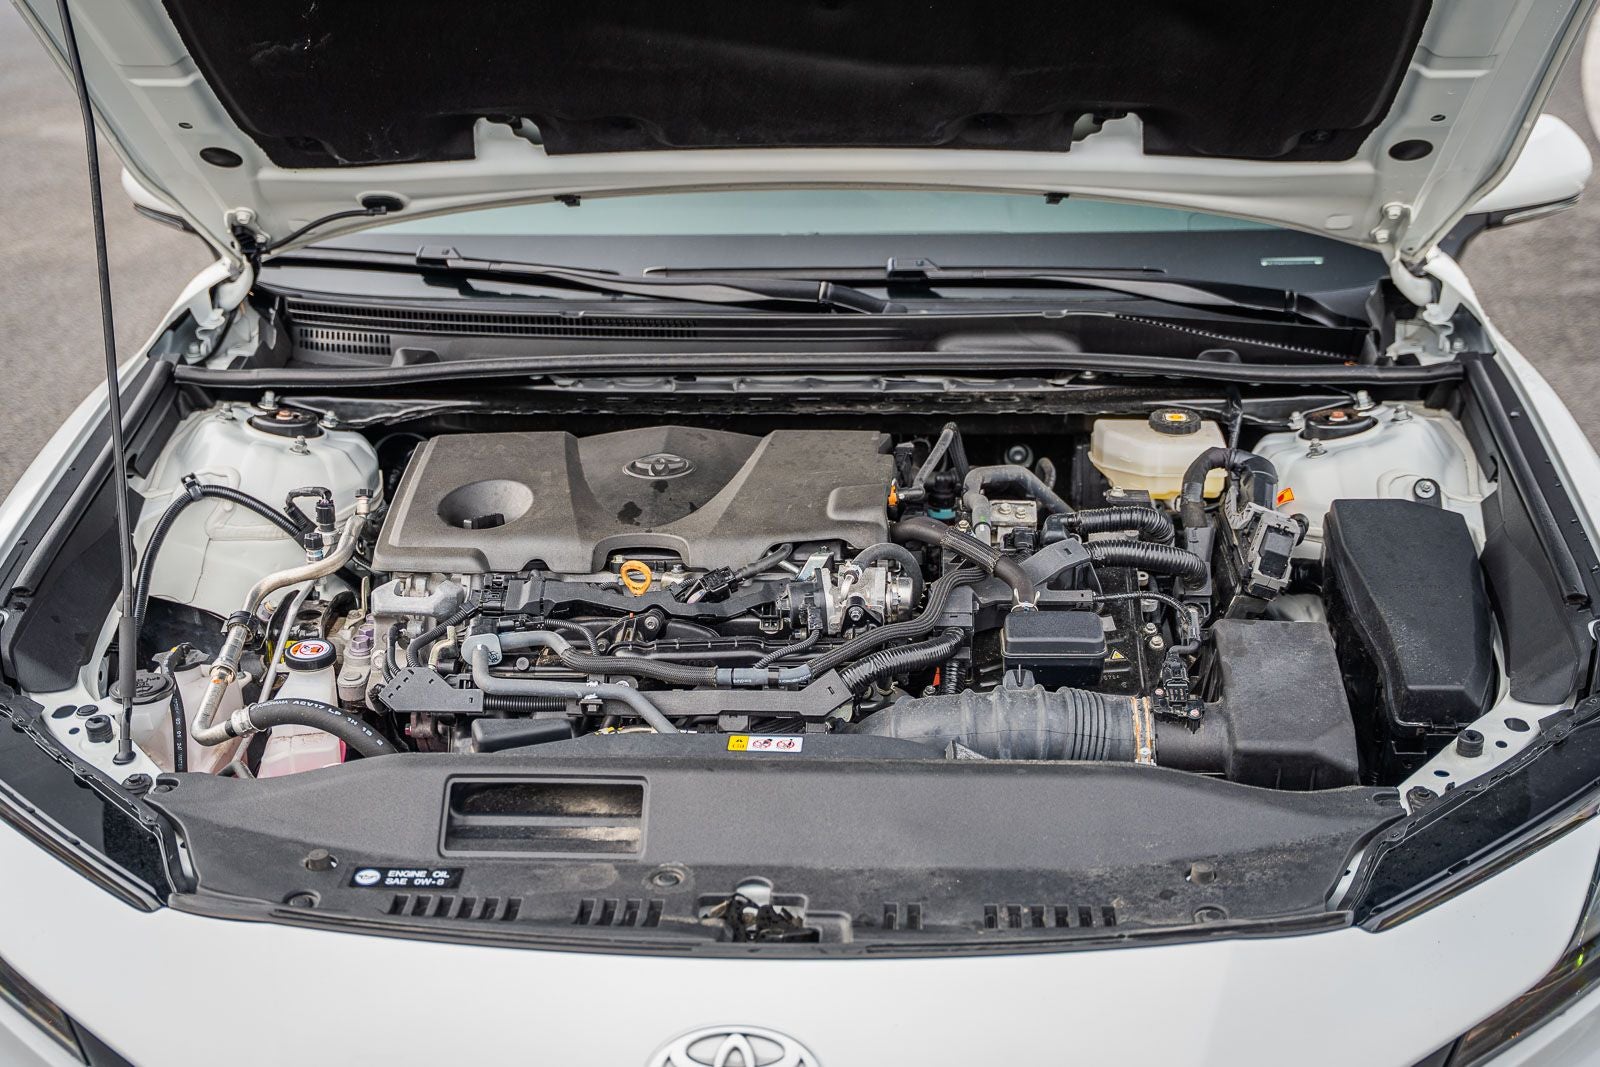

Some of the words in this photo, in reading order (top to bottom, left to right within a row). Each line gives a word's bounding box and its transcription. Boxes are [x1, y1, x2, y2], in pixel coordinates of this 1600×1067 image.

[387, 869, 428, 878] ENGINE
[432, 870, 450, 879] OIL
[384, 877, 408, 886] SAE
